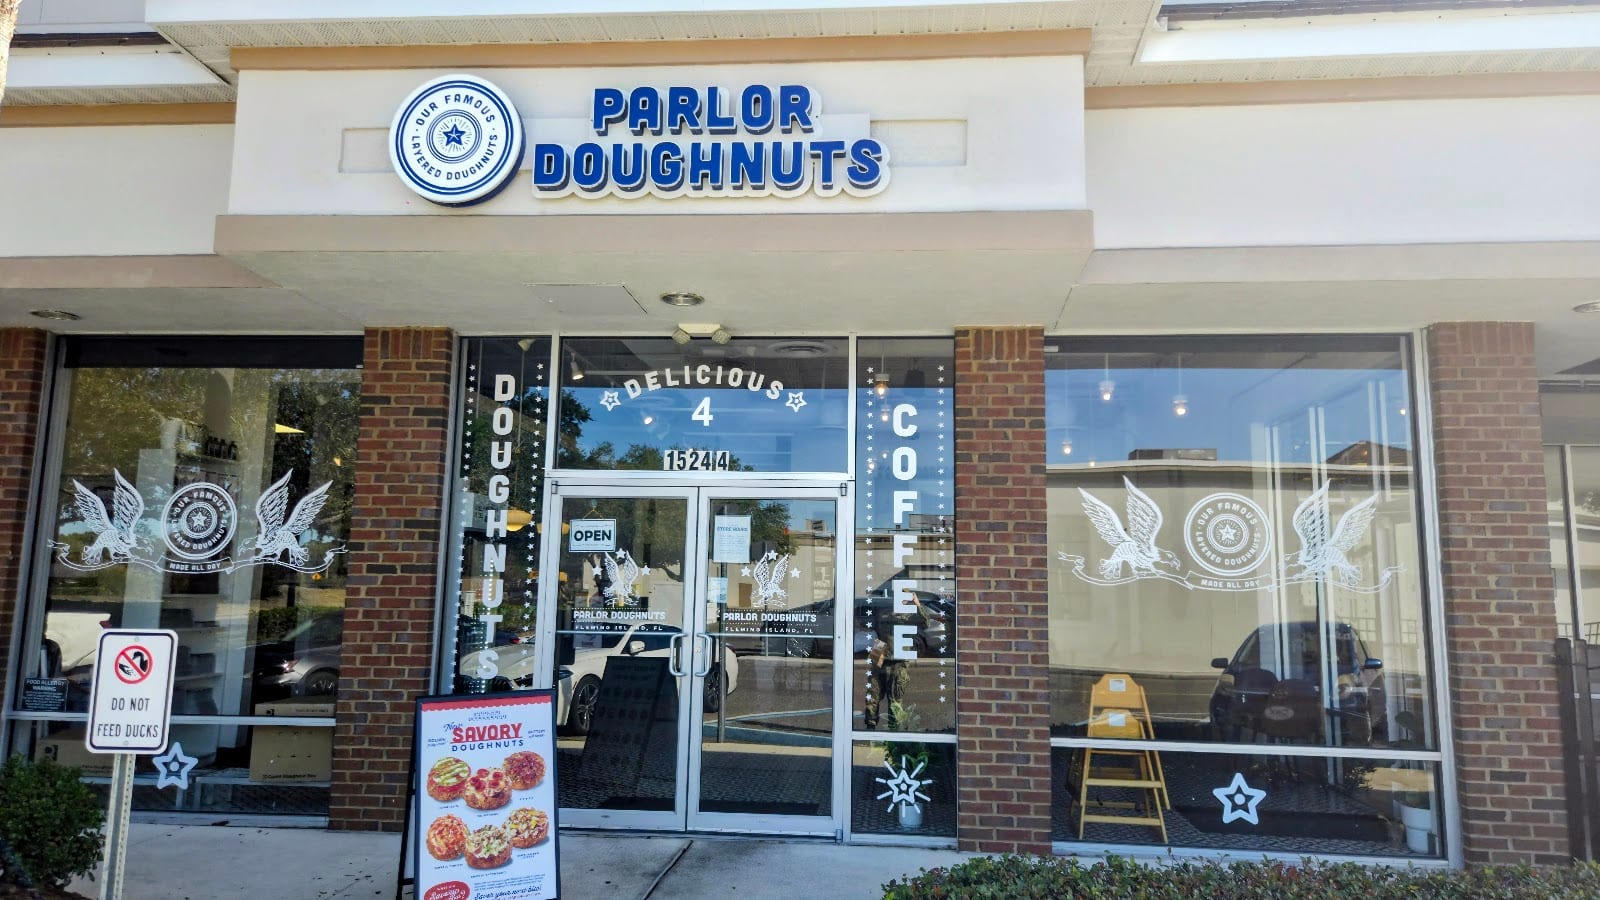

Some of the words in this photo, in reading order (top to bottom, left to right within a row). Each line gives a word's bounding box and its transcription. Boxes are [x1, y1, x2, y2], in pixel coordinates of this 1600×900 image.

[415, 101, 439, 126] OUR
[444, 93, 496, 123] FAMOUS
[593, 85, 817, 137] PARLOR
[411, 135, 442, 178] LAYERED
[446, 134, 498, 180] DOUGHNUTS
[534, 139, 885, 192] DOUGHNUTS
[623, 364, 784, 400] DELICIOUS
[691, 396, 713, 427] 4
[174, 496, 190, 513] OUR
[193, 491, 227, 512] FAMOUS
[1198, 507, 1214, 526] OUR
[1217, 502, 1258, 525] FAMOUS
[477, 374, 516, 680] DOUGHNUTS
[573, 529, 612, 541] OPEN
[892, 403, 919, 660] COFFEE
[1196, 531, 1221, 564] LAYERED
[169, 562, 189, 571] MADE
[207, 562, 221, 570] DAY
[1201, 579, 1224, 588] MADE
[1244, 579, 1260, 588] DAY
[573, 610, 609, 619] PARLOR
[610, 611, 666, 621] DOUGHNUTS
[722, 612, 758, 621] PARLOR
[760, 613, 817, 623] DOUGHNUTS
[111, 697, 125, 711] DO
[129, 698, 150, 712] NOT
[97, 723, 121, 737] FEED
[125, 724, 159, 738] DUCKS
[452, 723, 522, 742] SAVORY
[451, 739, 524, 752] DOUGHNUTS
